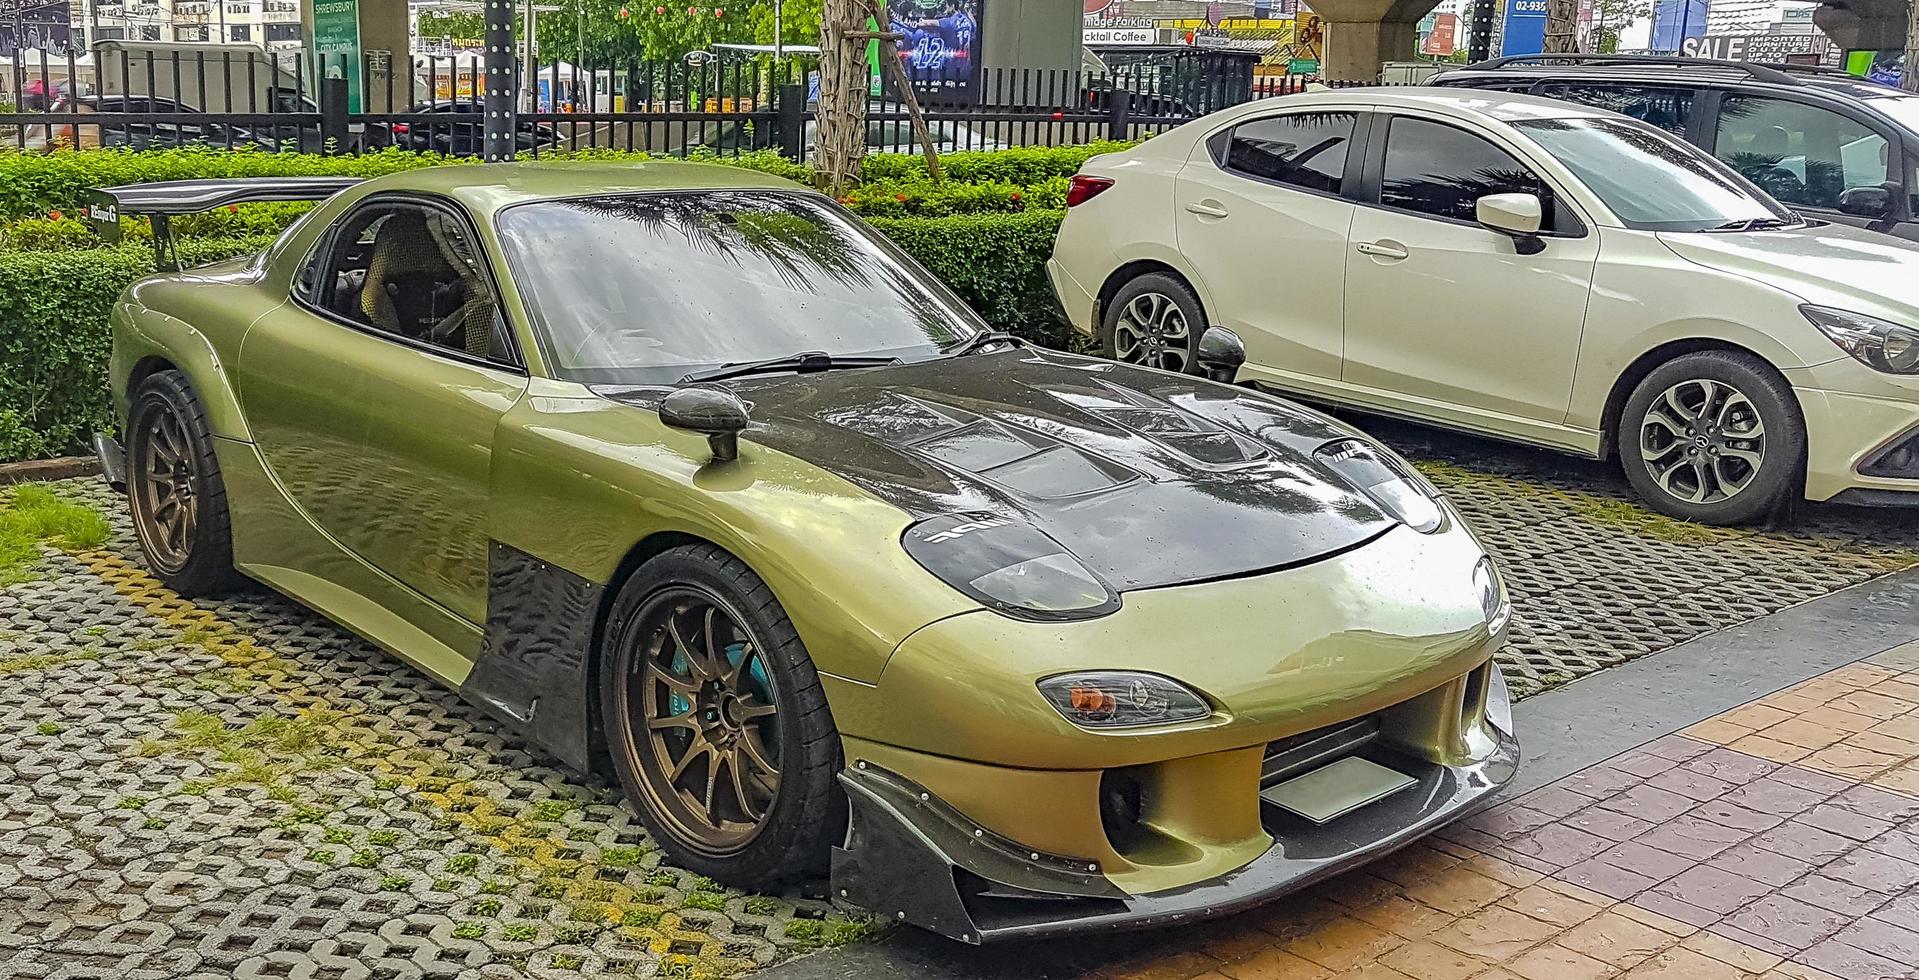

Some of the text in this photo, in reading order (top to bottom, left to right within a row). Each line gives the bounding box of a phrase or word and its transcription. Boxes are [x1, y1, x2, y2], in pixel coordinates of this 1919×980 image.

[315, 1, 354, 14] SHREWSBURY
[1115, 17, 1153, 28] Parking
[1084, 32, 1147, 41] cktail Coffee
[1683, 37, 1745, 62] SALE
